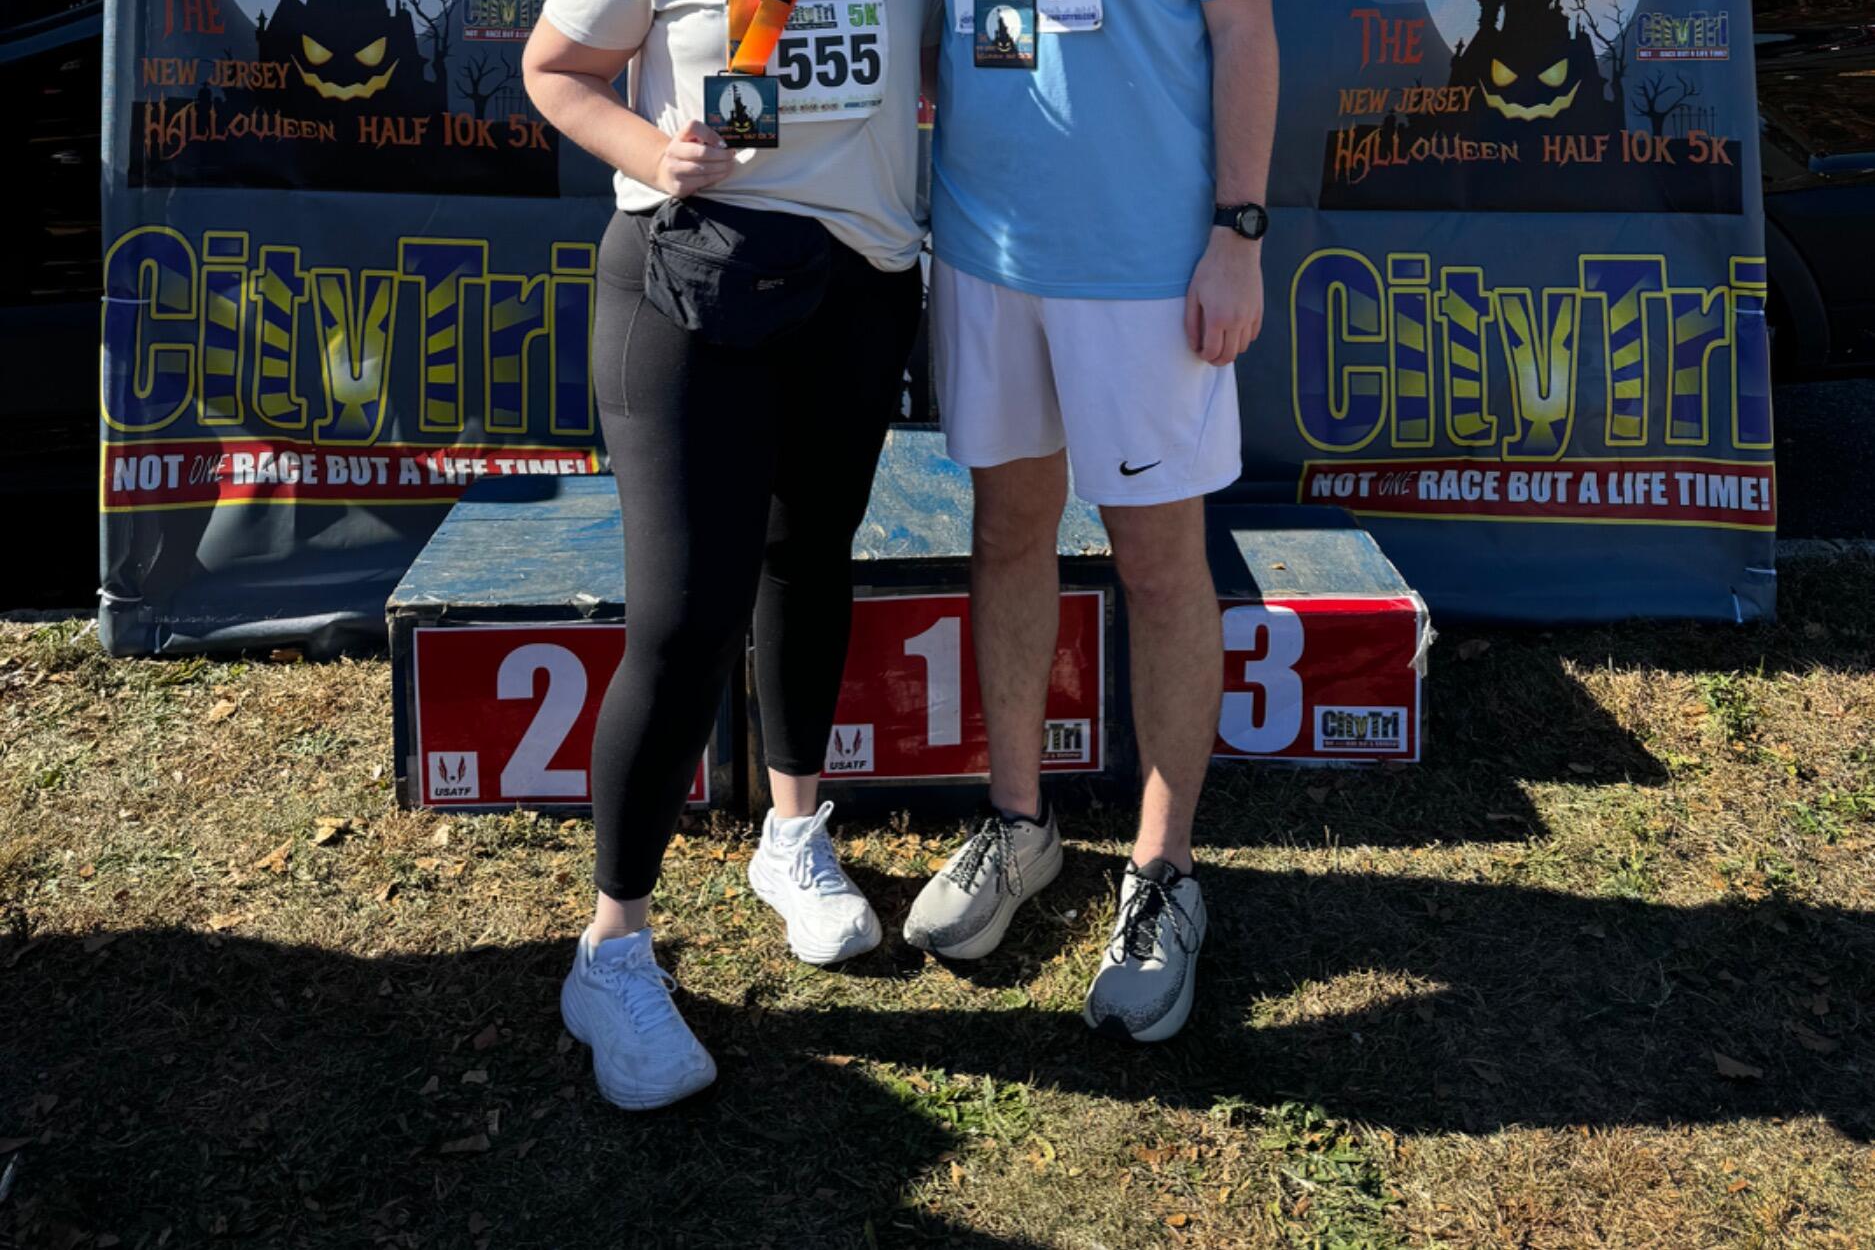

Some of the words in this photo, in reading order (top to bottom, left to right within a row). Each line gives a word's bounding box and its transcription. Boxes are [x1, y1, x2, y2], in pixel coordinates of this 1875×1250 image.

[847, 2, 880, 28] 5K
[1636, 10, 1729, 48] CityTri
[1350, 8, 1426, 71] THE
[142, 57, 199, 90] NEW
[207, 59, 291, 89] JERSEY
[1338, 87, 1391, 115] NEW
[1394, 85, 1477, 115] JERSEY
[143, 92, 338, 162] HALLOWEEN
[358, 114, 431, 150] HALF
[443, 111, 497, 150] 10K
[508, 112, 551, 151] 5K
[1333, 124, 1521, 185] HALLOWEEN
[1542, 133, 1610, 167] HALF
[1620, 129, 1676, 165] 10K
[1686, 129, 1734, 167] 5K
[101, 224, 599, 447] CityTri
[1290, 247, 1775, 463] CityTri
[112, 453, 185, 492] NOT
[188, 452, 230, 486] ONE
[231, 450, 319, 486] RACE
[326, 455, 393, 487] BUT
[399, 455, 422, 486] A
[1311, 472, 1375, 498] NOT
[1378, 470, 1418, 498] ONE
[1418, 469, 1500, 503] RACE
[1507, 470, 1574, 504] BUT
[1578, 471, 1601, 505] A
[1607, 470, 1669, 506] LIFE
[1674, 472, 1772, 512] TIME!
[904, 616, 961, 747] 1
[1217, 605, 1305, 753] 3
[496, 643, 588, 798] 2
[1321, 710, 1400, 740] CityTri
[829, 759, 869, 771] USATF
[434, 785, 473, 797] USATF
